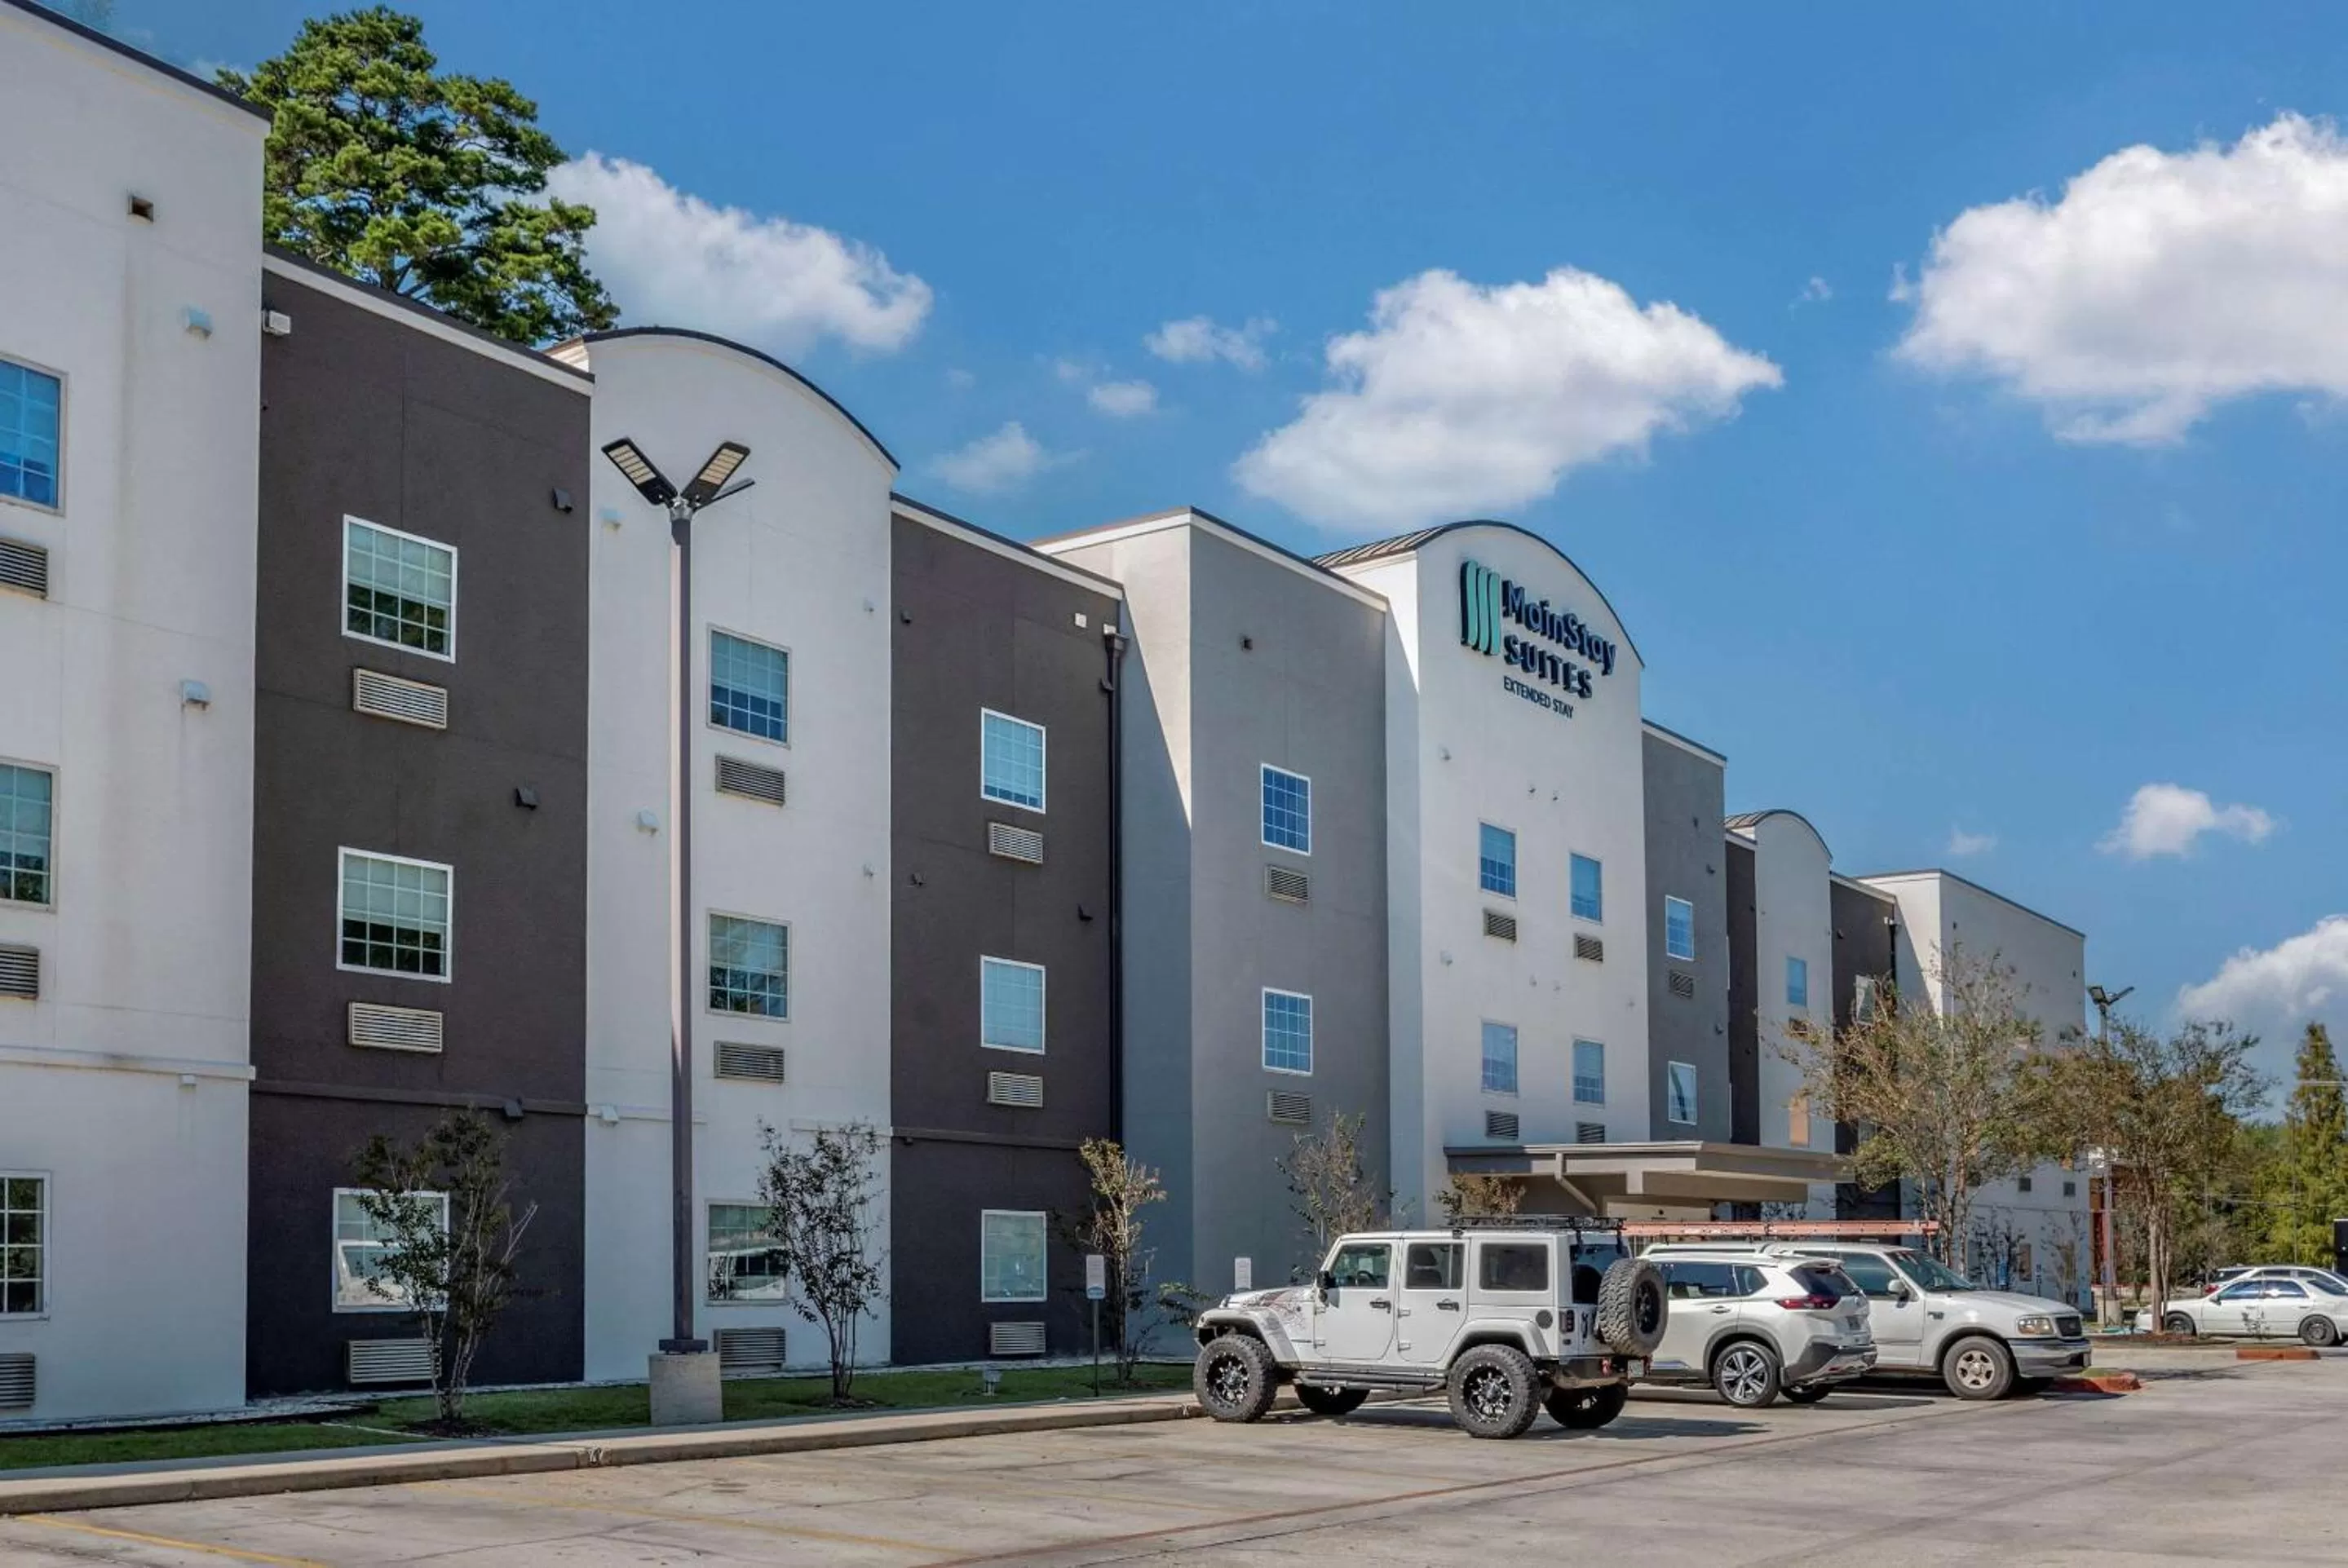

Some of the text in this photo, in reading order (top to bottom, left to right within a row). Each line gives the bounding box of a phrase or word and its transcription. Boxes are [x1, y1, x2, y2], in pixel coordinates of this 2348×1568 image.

[1501, 579, 1616, 676] MainStay
[1503, 634, 1592, 699] SUITES
[1503, 675, 1574, 718] EXTENDED STAY
